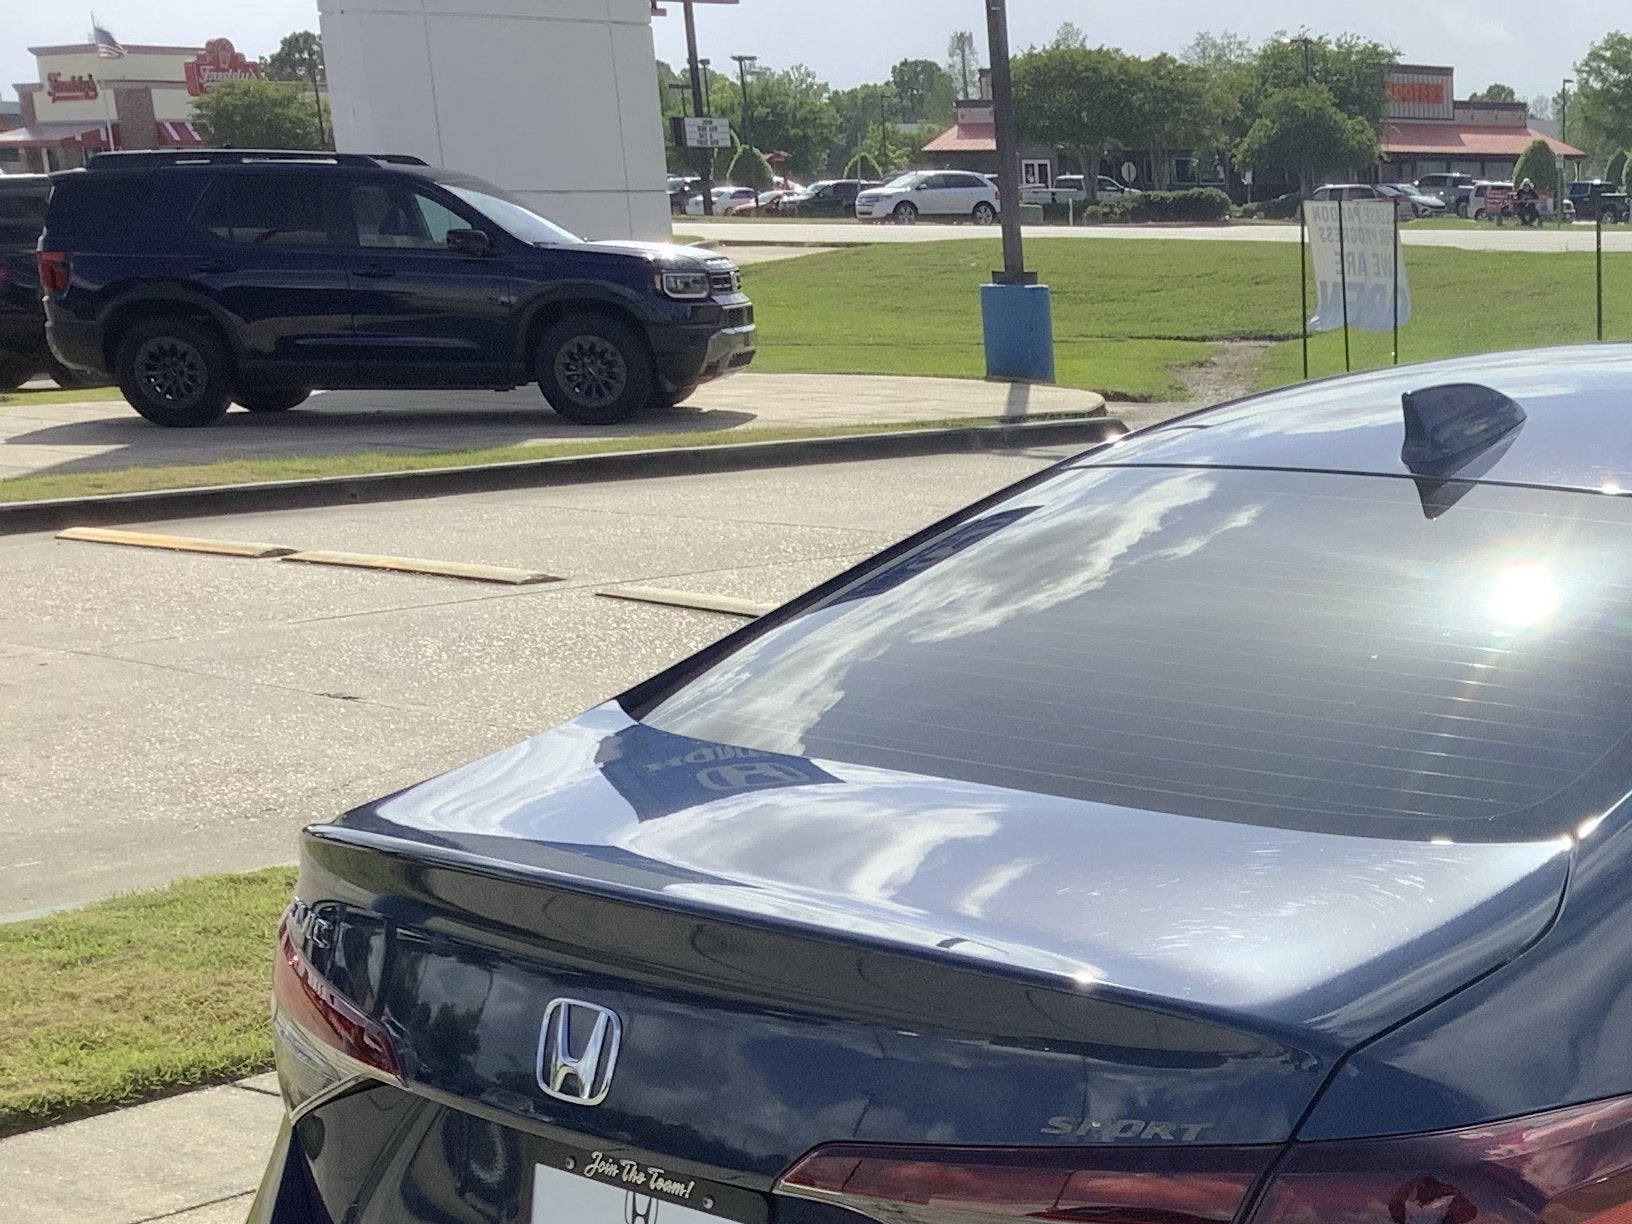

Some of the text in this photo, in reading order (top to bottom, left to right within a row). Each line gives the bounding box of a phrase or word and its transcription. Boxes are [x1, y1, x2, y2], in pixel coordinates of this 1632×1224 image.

[1041, 1116, 1214, 1142] SPORT
[584, 1151, 695, 1198] Join The Team!
